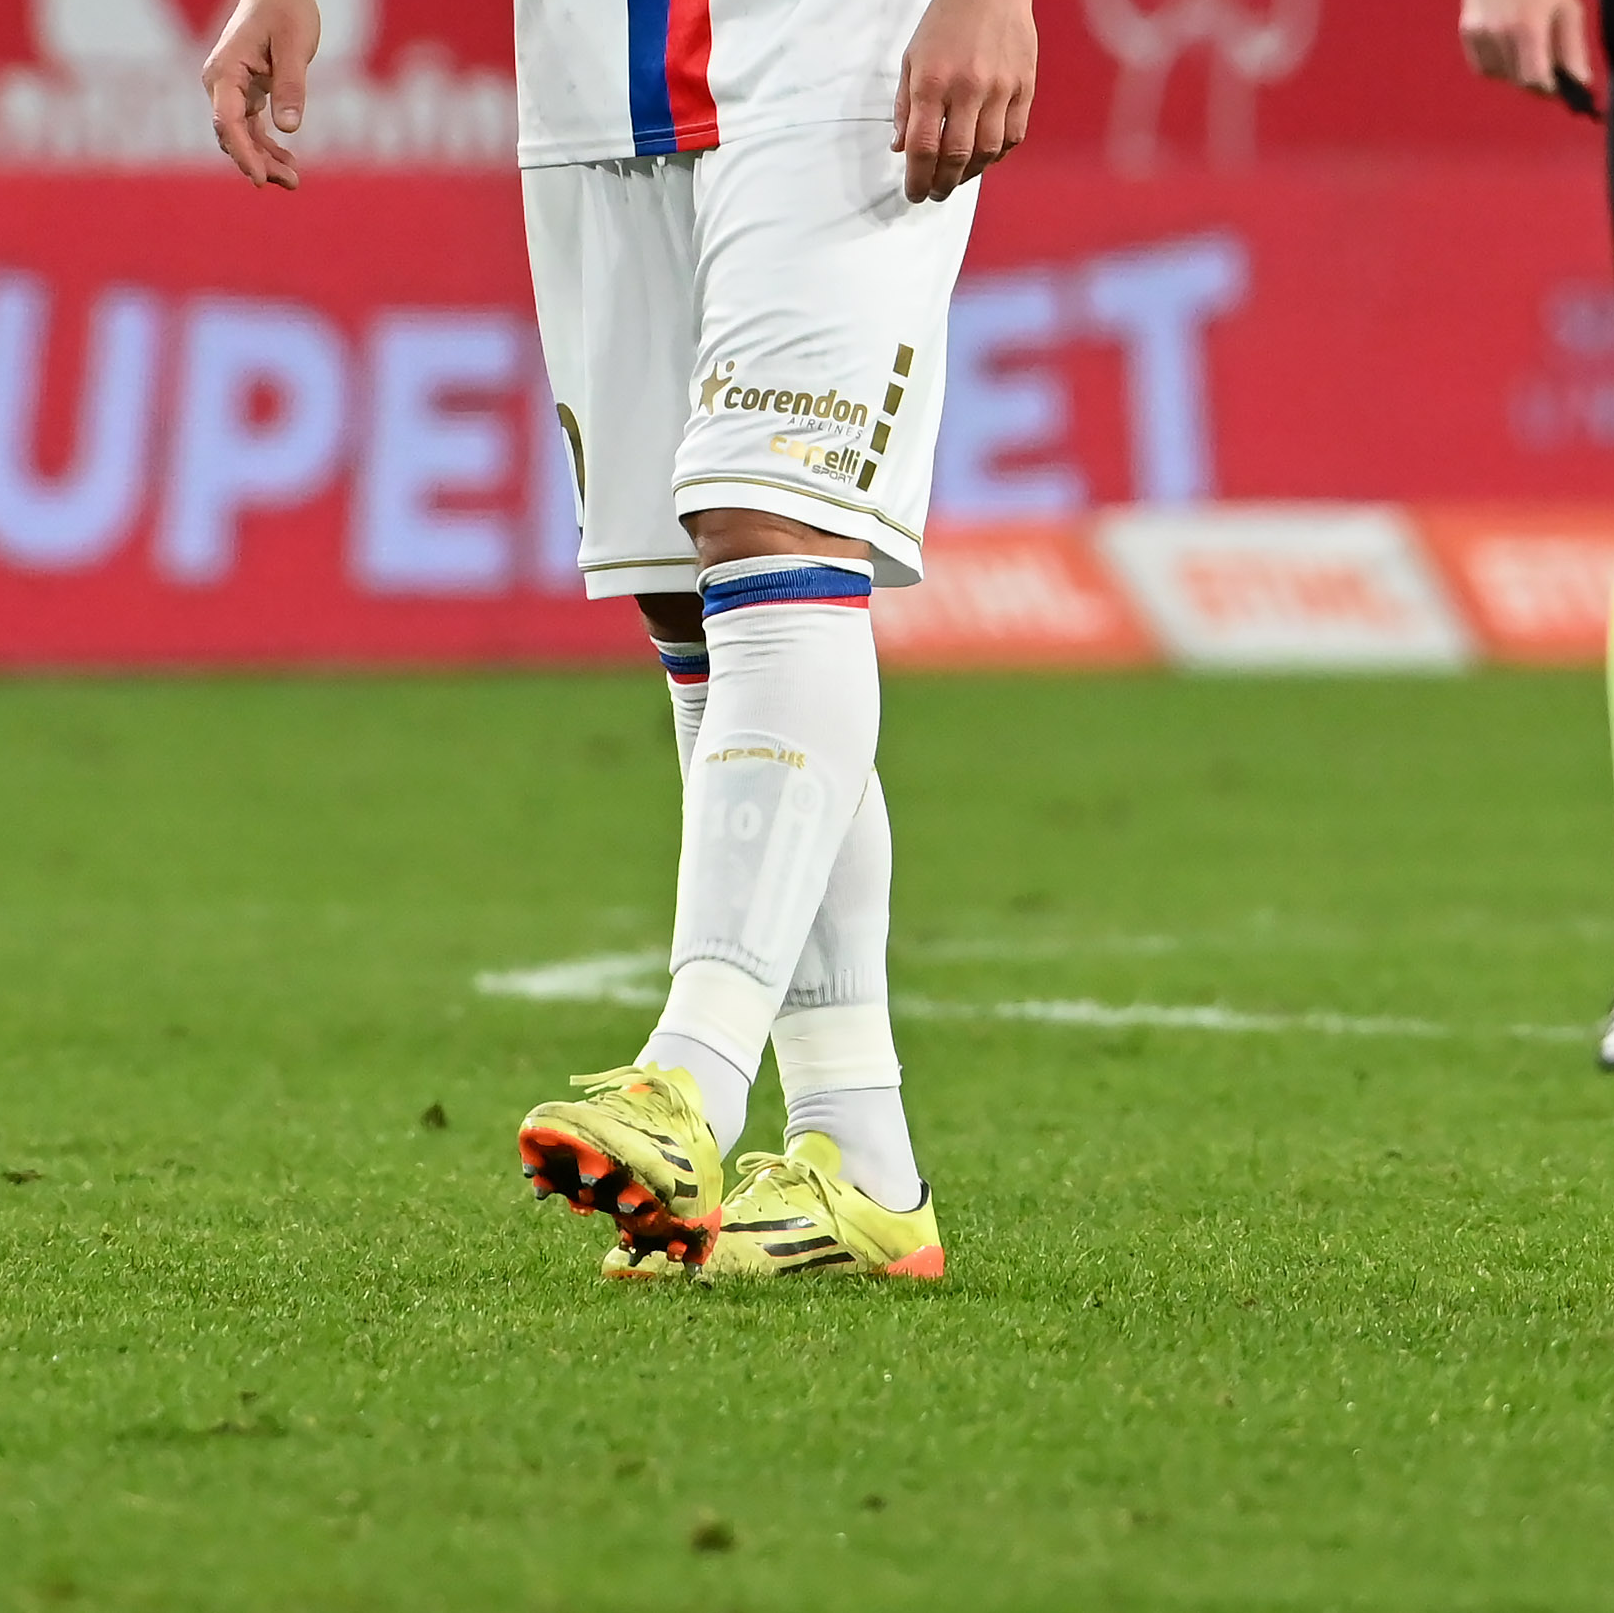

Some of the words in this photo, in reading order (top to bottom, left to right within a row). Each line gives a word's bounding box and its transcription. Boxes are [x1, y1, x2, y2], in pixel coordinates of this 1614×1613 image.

[724, 386, 868, 428] corendon
[787, 417, 864, 440] AIRLINES
[770, 435, 861, 475] capelli
[811, 464, 854, 485] SPORT
